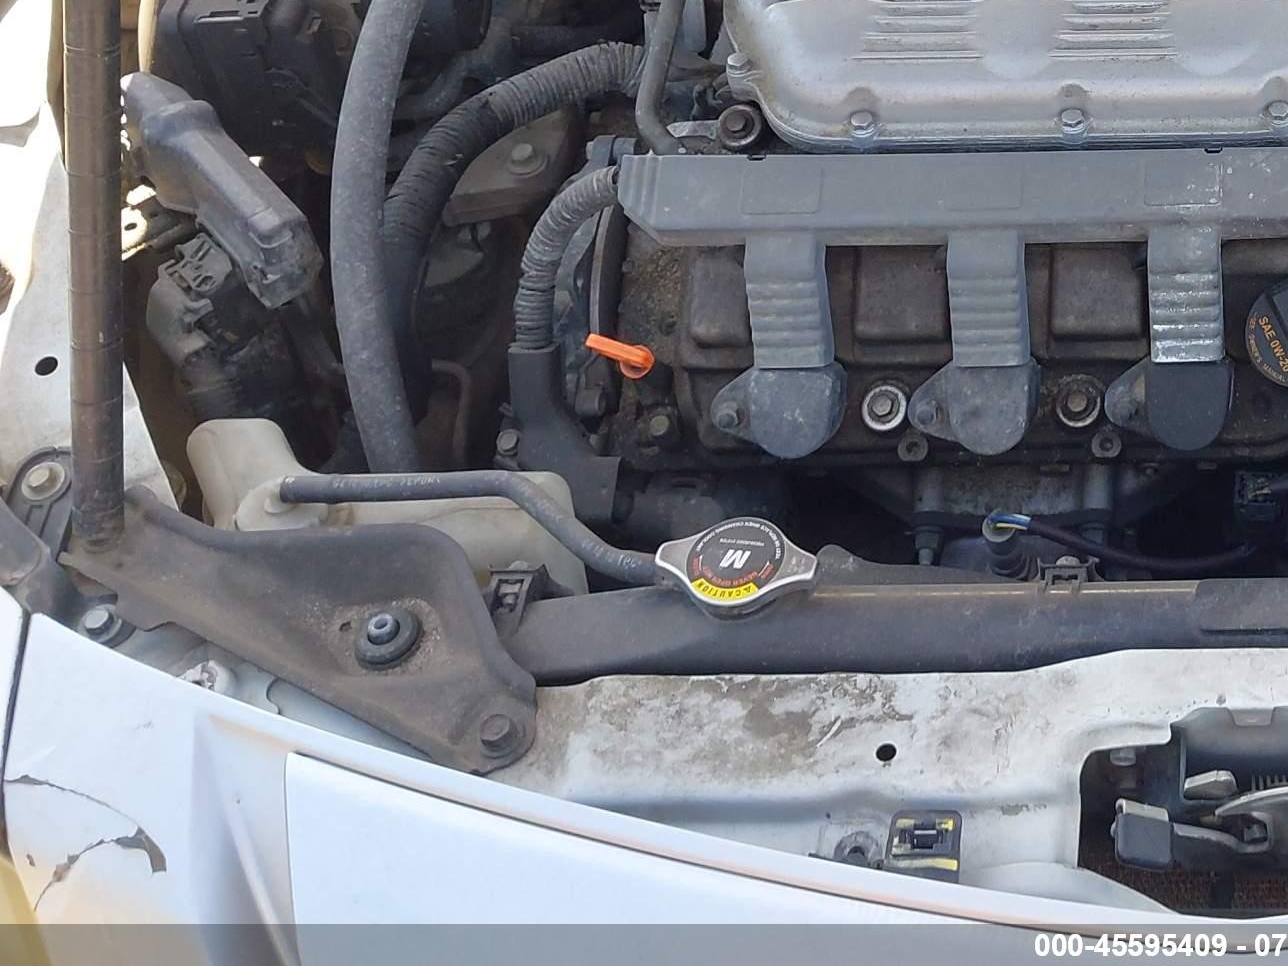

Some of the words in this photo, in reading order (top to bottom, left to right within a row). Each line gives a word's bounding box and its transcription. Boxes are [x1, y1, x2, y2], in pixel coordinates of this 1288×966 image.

[1258, 315, 1276, 340] SAE
[719, 548, 752, 569] M
[698, 580, 741, 598] CAUTION
